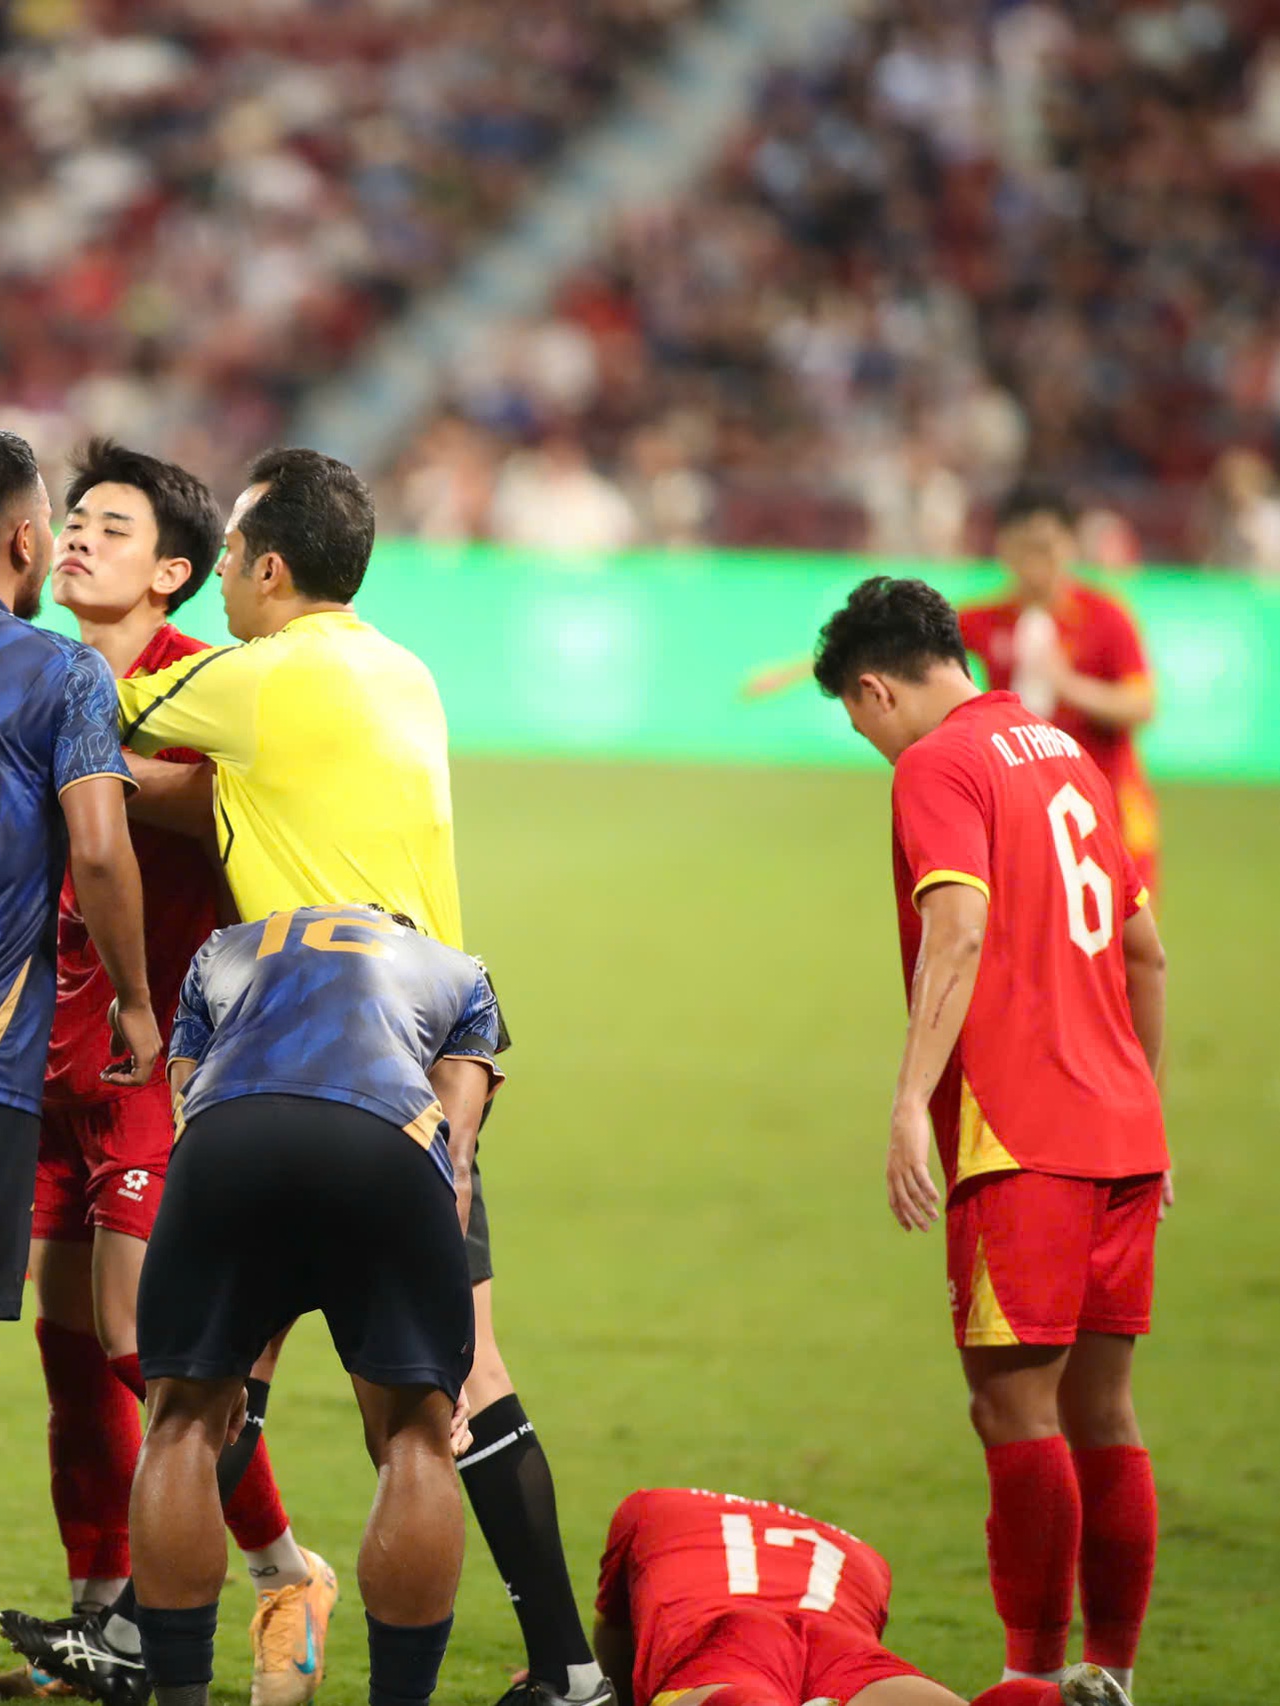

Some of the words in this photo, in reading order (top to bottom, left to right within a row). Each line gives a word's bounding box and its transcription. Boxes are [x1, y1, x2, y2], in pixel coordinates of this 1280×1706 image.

[1047, 781, 1113, 959] 6
[255, 903, 406, 960] 12
[721, 1513, 846, 1613] 17
